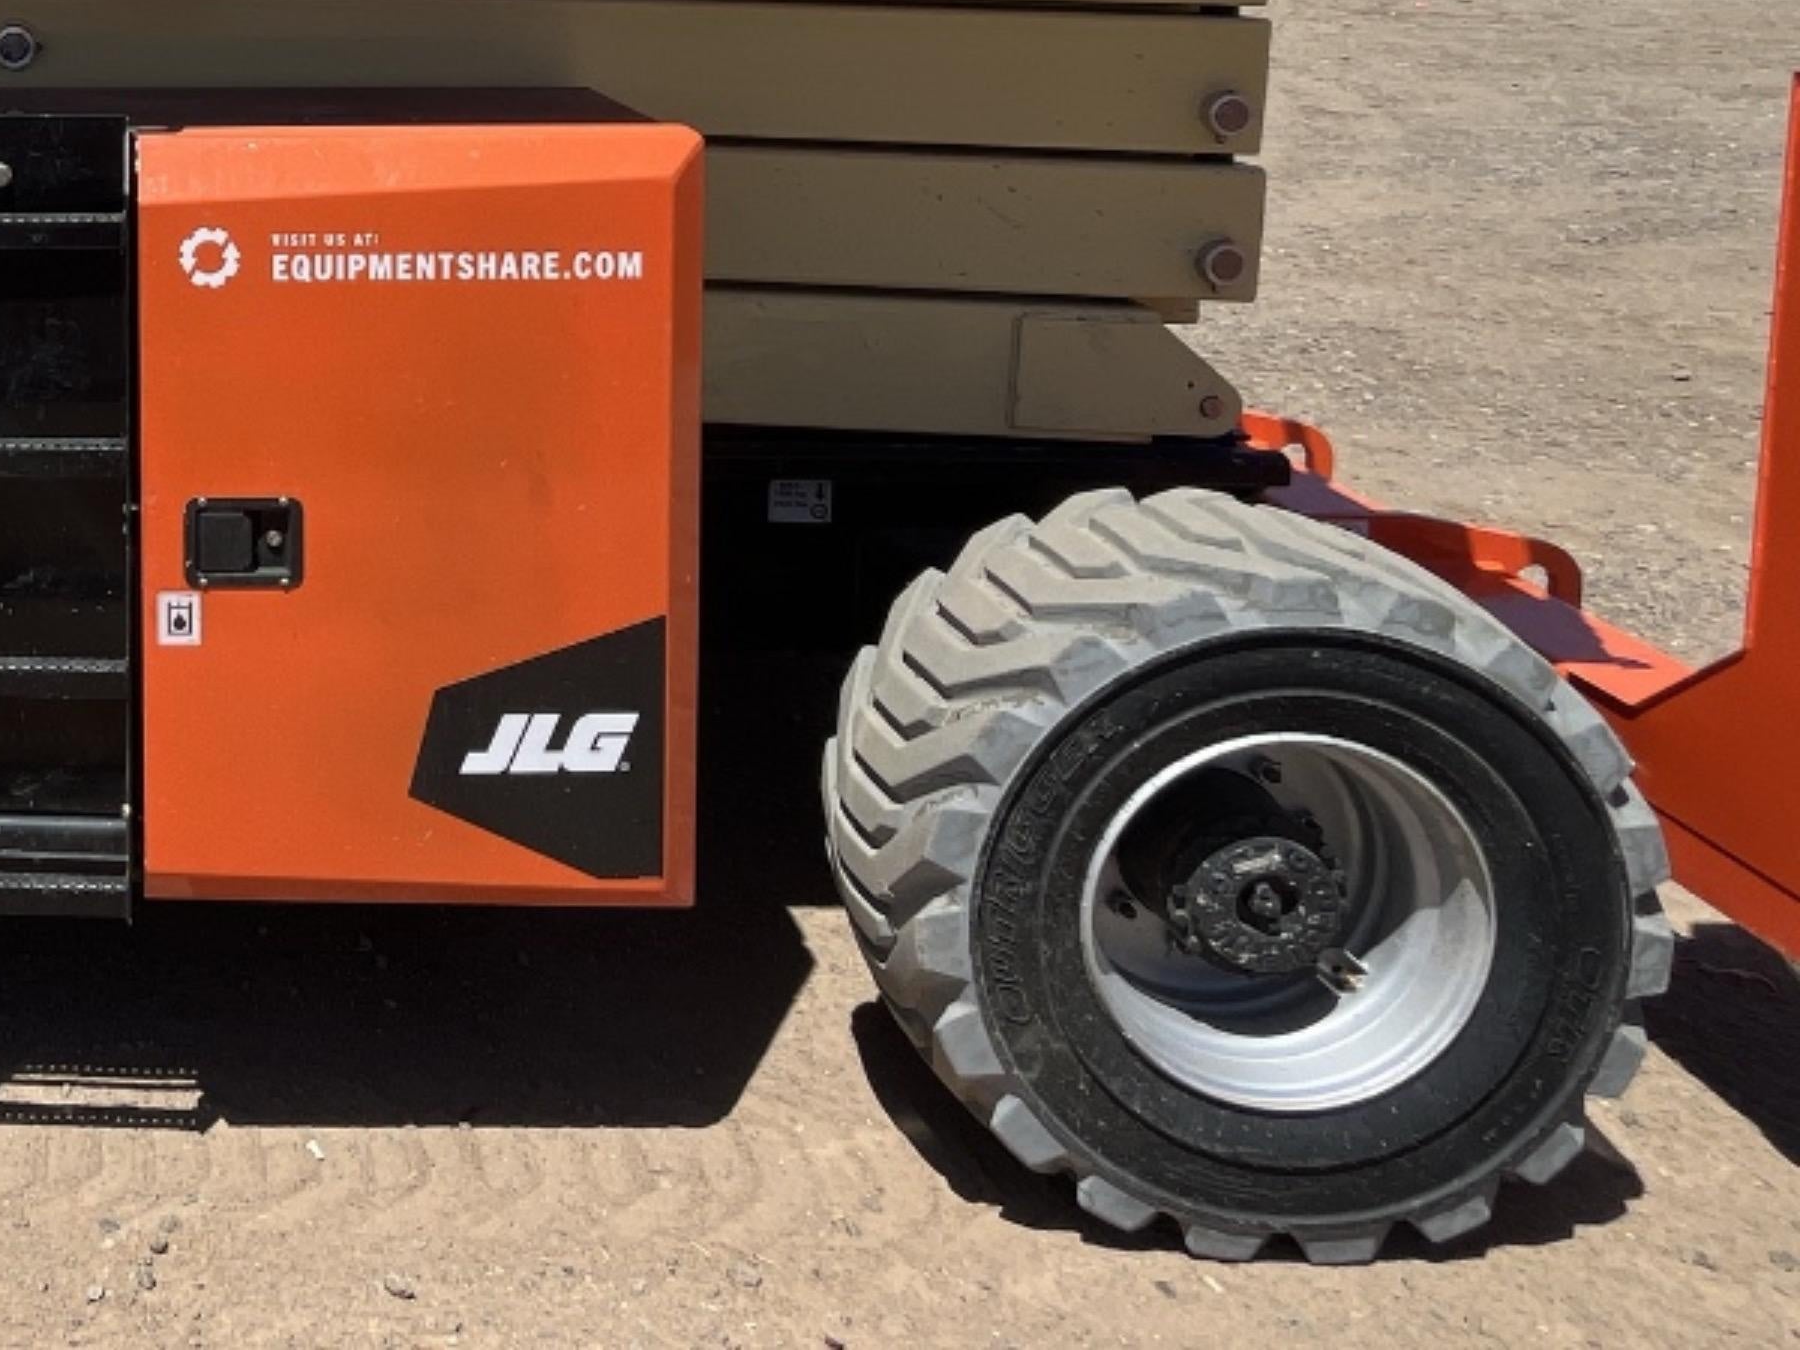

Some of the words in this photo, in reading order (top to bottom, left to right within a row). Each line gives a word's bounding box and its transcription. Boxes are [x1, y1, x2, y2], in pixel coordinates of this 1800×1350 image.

[271, 232, 317, 247] VISIT
[323, 232, 346, 247] US
[272, 251, 643, 282] EQUIPMENTSHARE.COM
[459, 712, 640, 775] JLG
